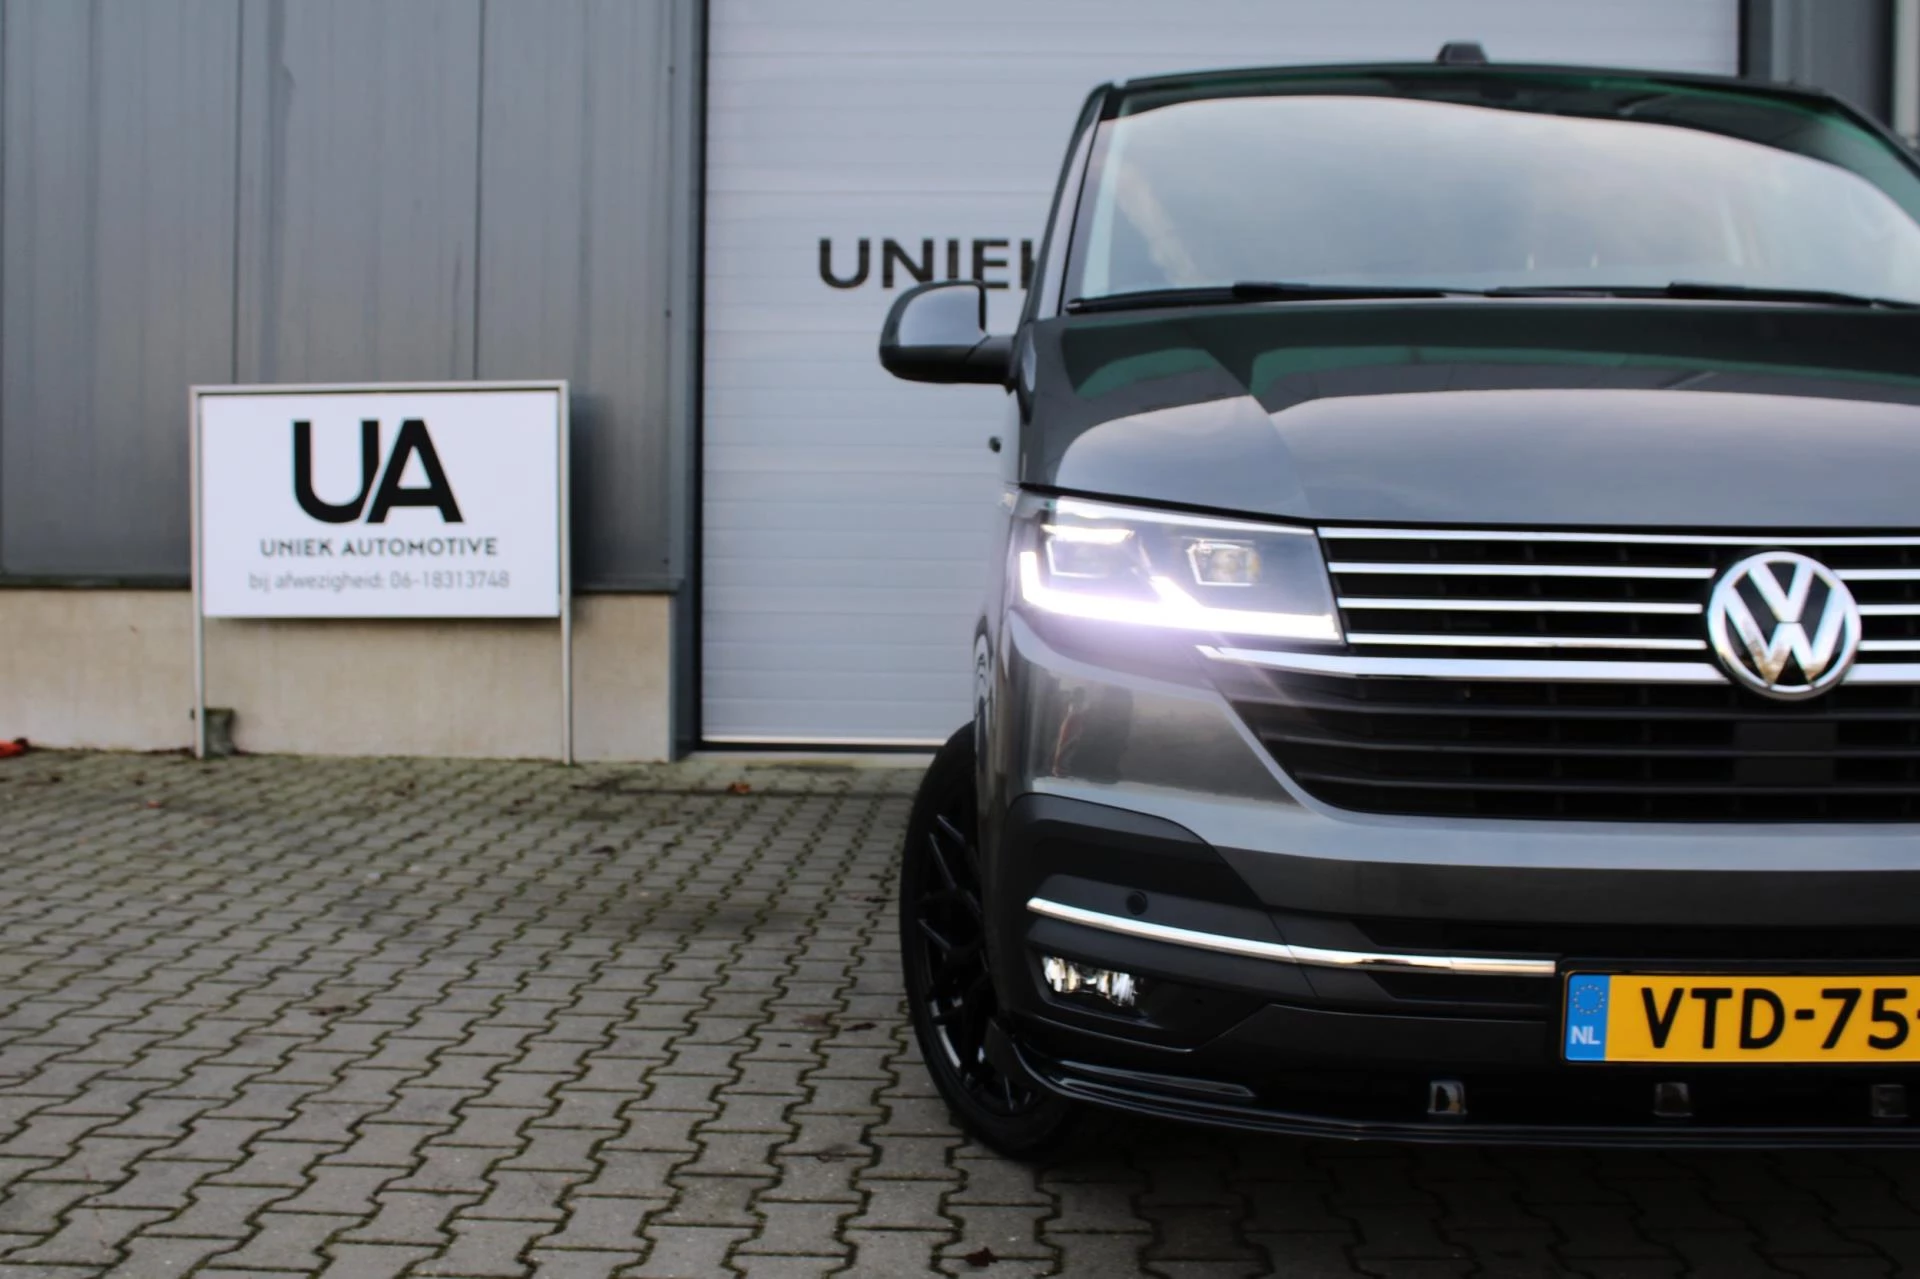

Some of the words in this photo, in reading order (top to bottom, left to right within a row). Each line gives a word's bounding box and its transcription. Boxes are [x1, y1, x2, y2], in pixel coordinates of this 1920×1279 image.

[293, 419, 464, 524] UA
[260, 539, 333, 557] UNIEK
[341, 537, 498, 556] AUTOMOTIVE
[248, 571, 271, 593] bij
[390, 570, 510, 589] 06-18313748
[1641, 987, 1920, 1050] VTD-75
[1570, 1026, 1601, 1046] NL
